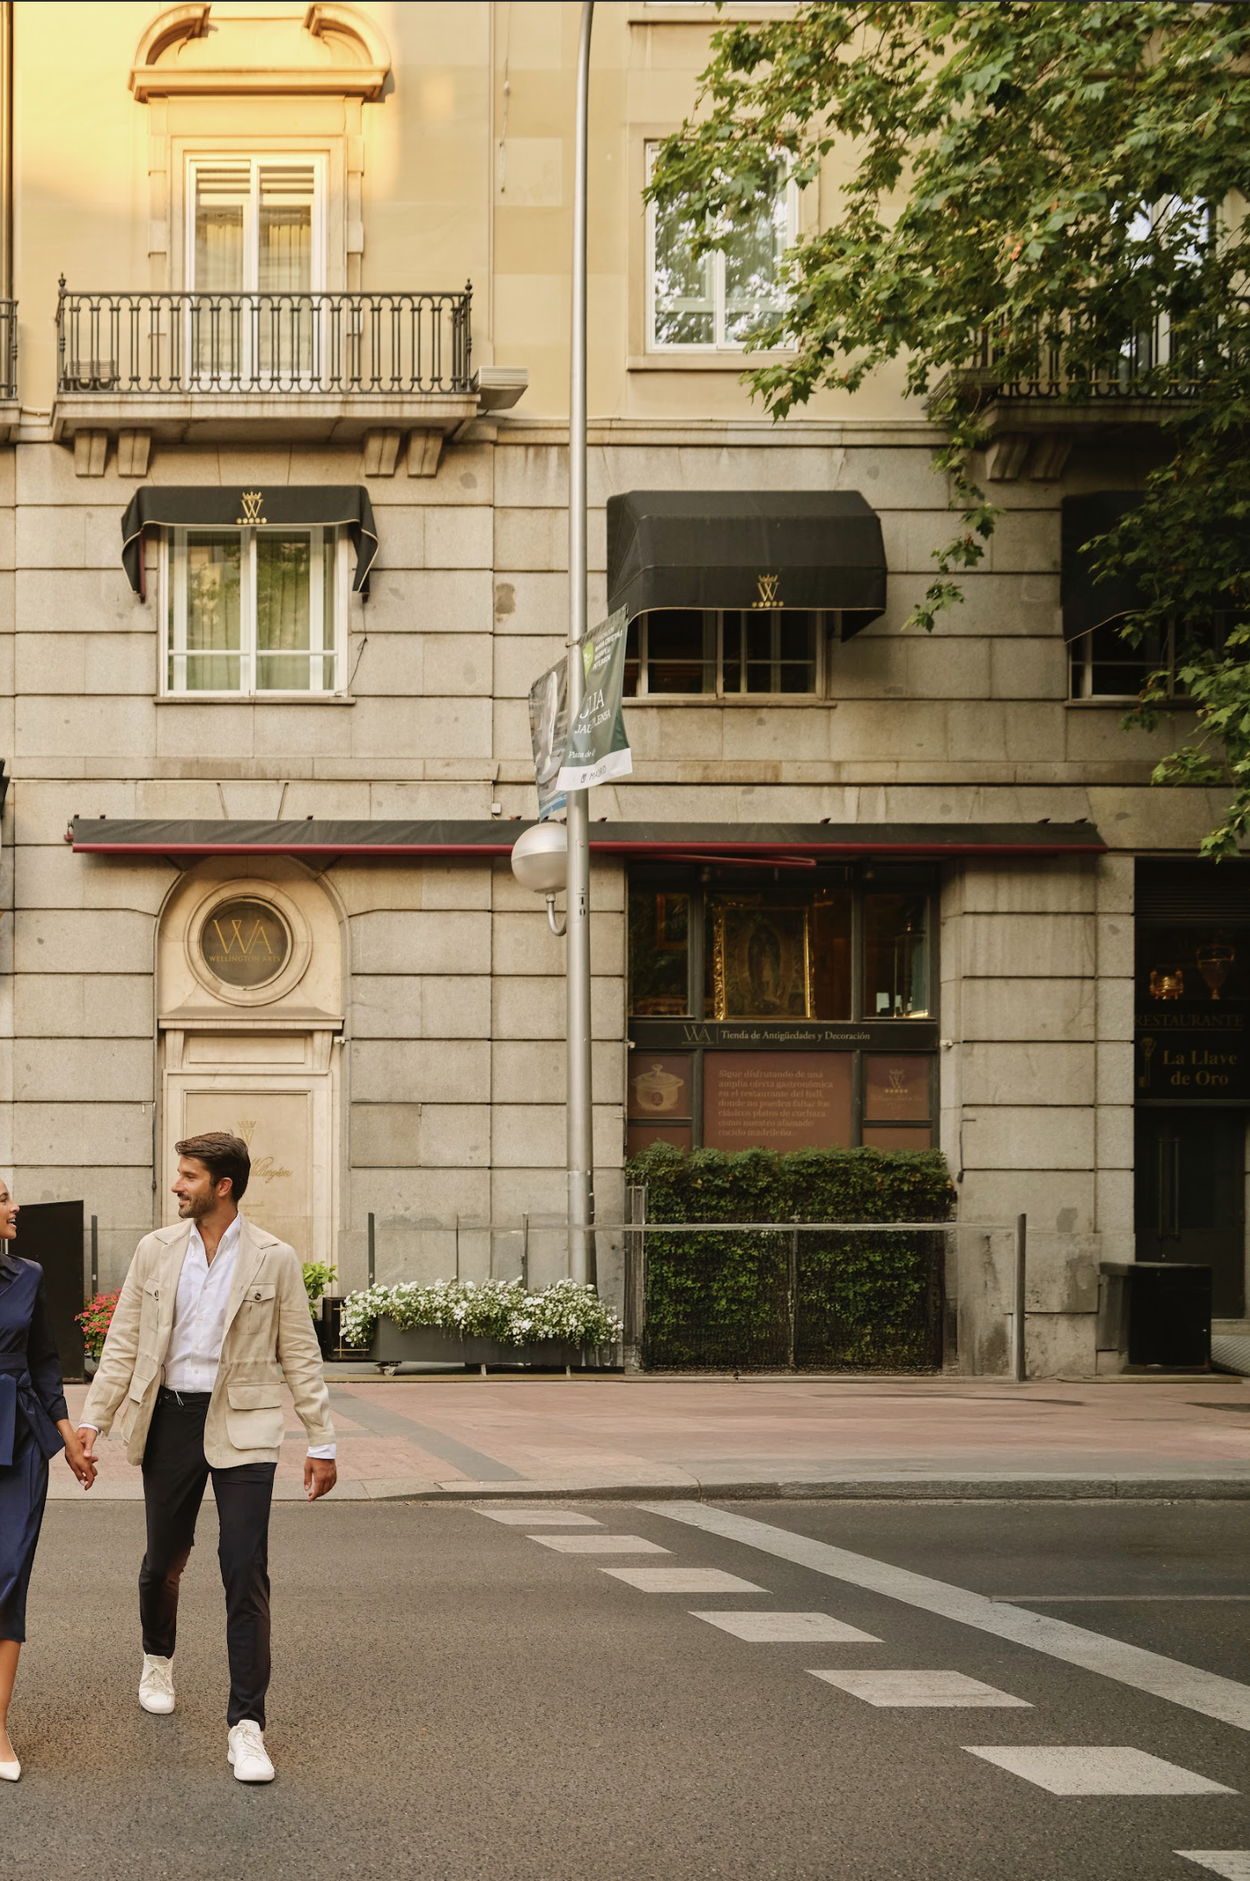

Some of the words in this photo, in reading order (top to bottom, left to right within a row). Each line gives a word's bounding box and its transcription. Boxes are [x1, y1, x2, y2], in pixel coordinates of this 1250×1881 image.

[720, 1029, 749, 1039] Tienda
[750, 1030, 761, 1039] de
[762, 1030, 816, 1042] Antigüedades
[817, 1033, 823, 1042] y
[824, 1031, 871, 1040] Decoración
[1163, 1050, 1185, 1065] La
[1191, 1050, 1238, 1065] Llave
[718, 1069, 743, 1079] Sigue
[743, 1069, 794, 1078] disfrutando
[794, 1069, 807, 1078] de
[1170, 1070, 1190, 1086] de
[1195, 1070, 1229, 1086] Oro
[718, 1079, 748, 1089] amplia
[749, 1079, 775, 1088] oferta
[776, 1080, 834, 1089] gastronómica
[730, 1089, 739, 1097] el
[790, 1089, 804, 1097] del
[718, 1099, 746, 1107] donde
[759, 1099, 791, 1108] pueden
[792, 1099, 817, 1107] faltar
[817, 1099, 831, 1107] los
[718, 1109, 751, 1117] clásicos
[752, 1109, 778, 1118] platos
[779, 1109, 791, 1117] de
[776, 1119, 814, 1127] afamado
[718, 1128, 746, 1136] cocido
